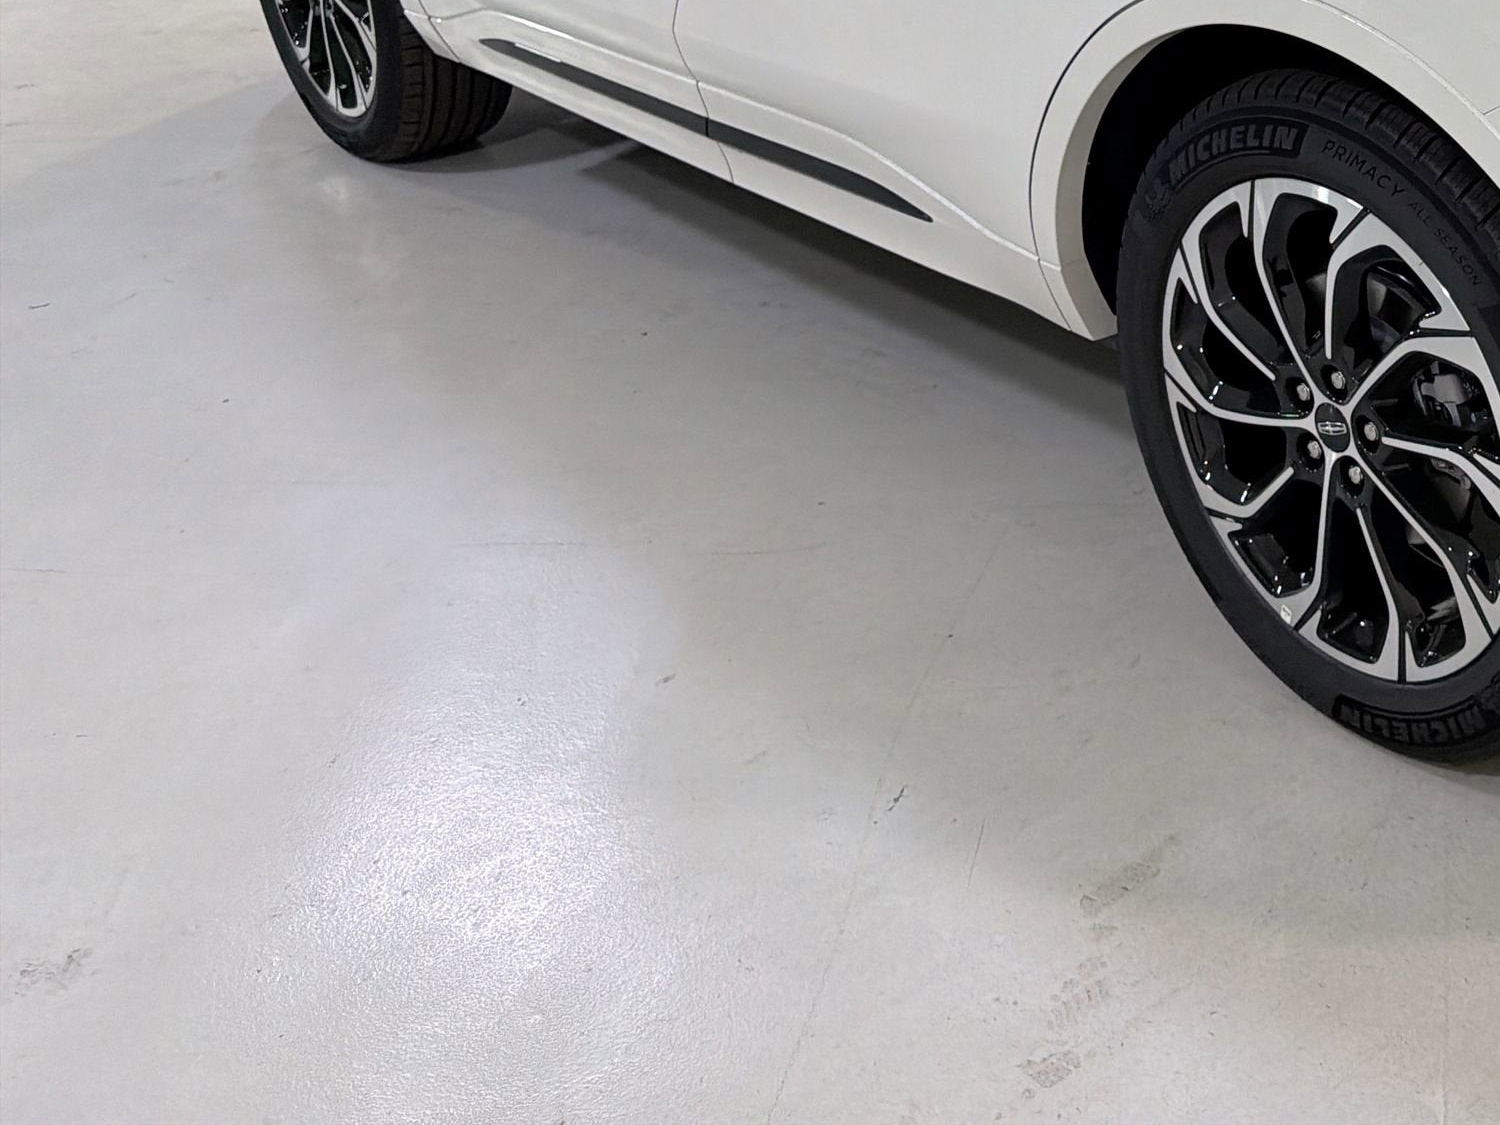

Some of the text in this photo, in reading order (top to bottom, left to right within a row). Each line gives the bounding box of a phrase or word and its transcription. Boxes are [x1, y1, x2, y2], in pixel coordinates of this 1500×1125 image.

[1168, 124, 1299, 185] MICHELIN
[1320, 138, 1482, 287] PRIMACY ALL SEASON
[1339, 702, 1488, 744] MICHELIN
